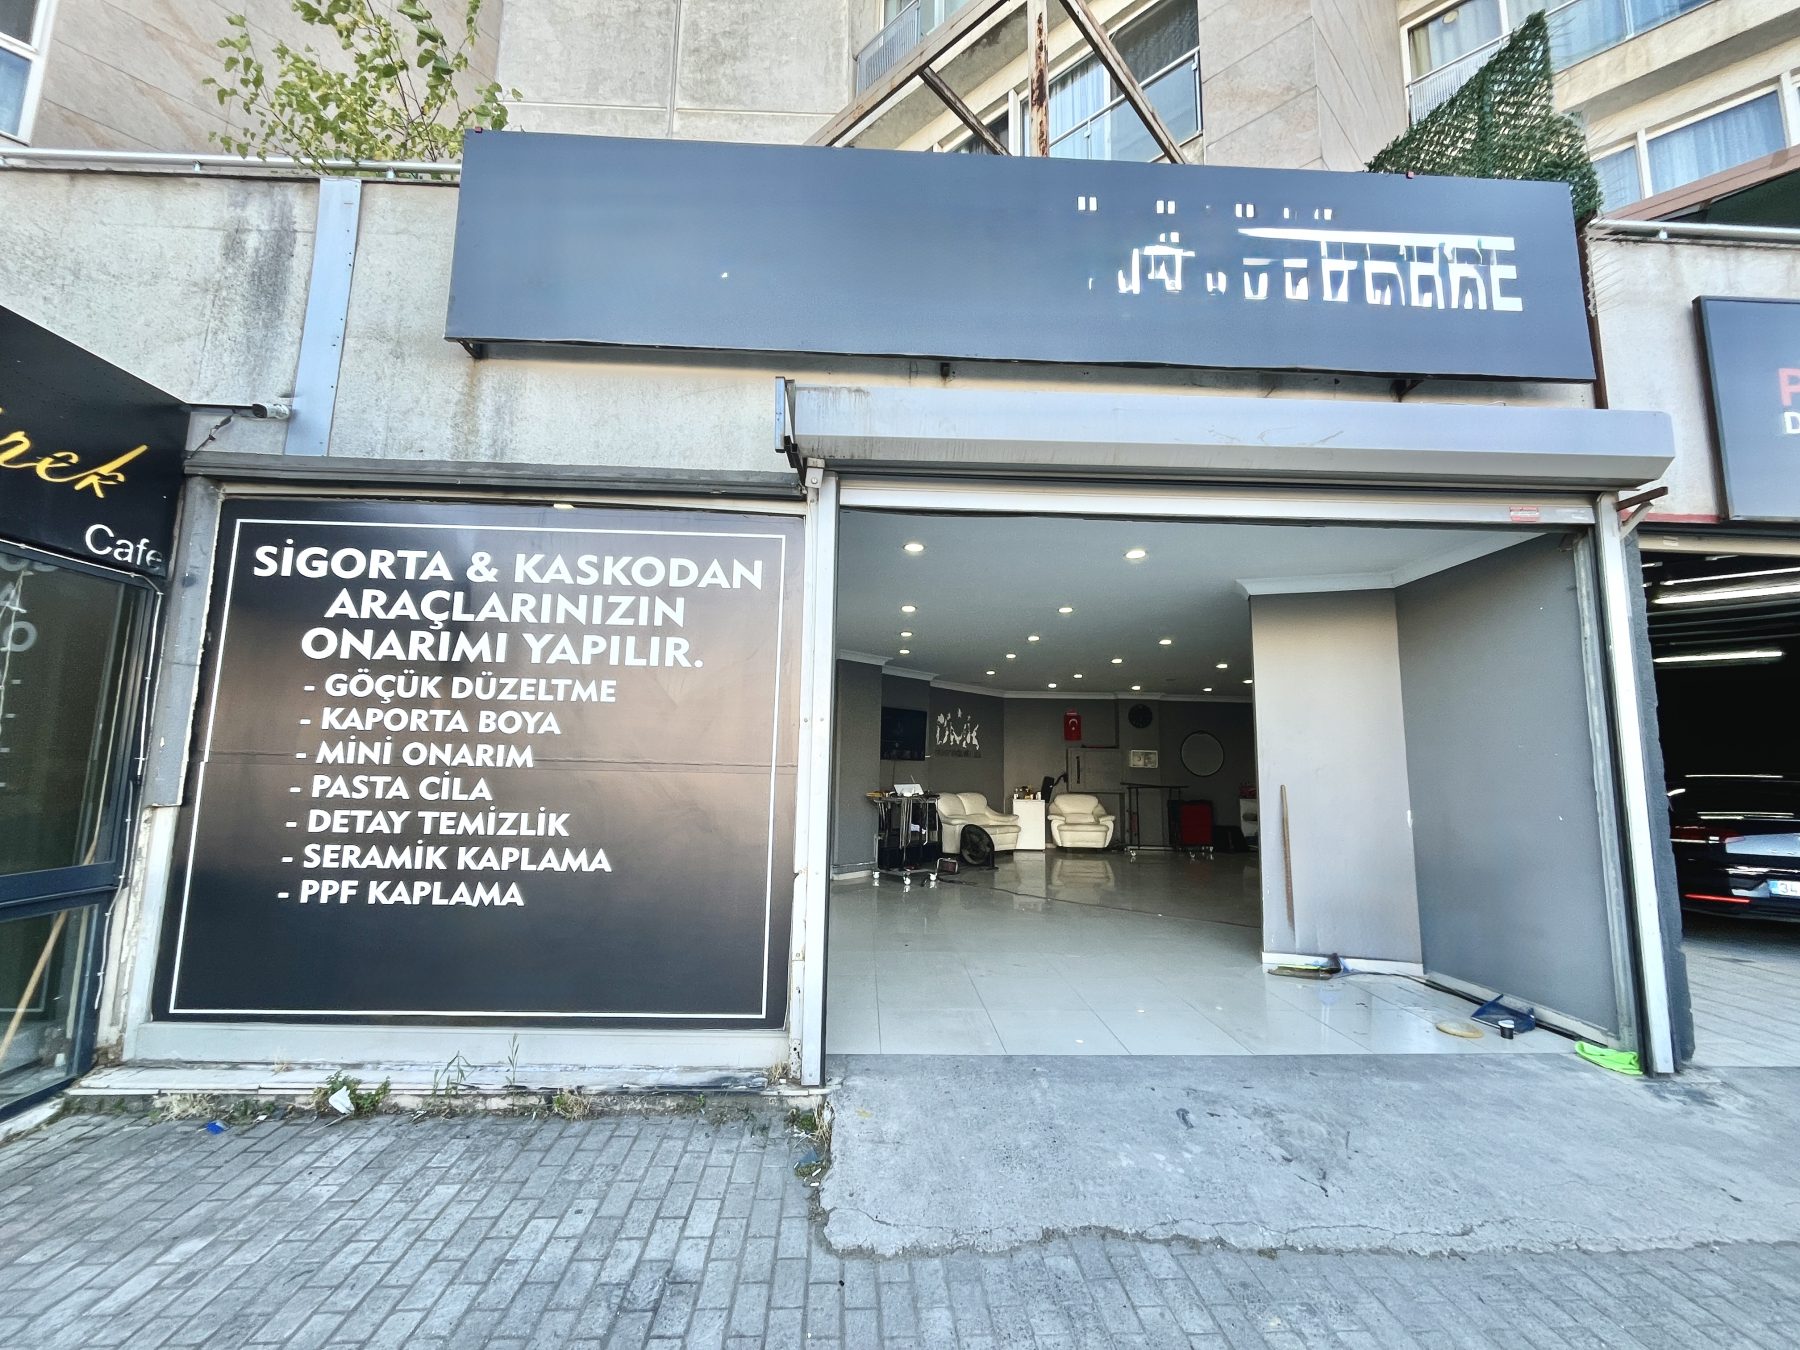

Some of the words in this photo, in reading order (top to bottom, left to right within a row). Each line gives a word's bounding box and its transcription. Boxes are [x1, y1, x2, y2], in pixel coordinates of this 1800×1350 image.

[85, 523, 163, 570] Cafe
[252, 538, 454, 581] SİGORTA
[466, 551, 498, 583] &
[514, 553, 763, 590] KASKODAN
[323, 587, 686, 631] ARAÇLARINIZIN
[301, 626, 508, 664] ONARIMI
[522, 633, 706, 668] YAPILIR.
[324, 668, 443, 704] GÖÇÜK
[451, 670, 617, 703] DÜZELTME
[321, 706, 469, 733] KAPORTA
[478, 710, 562, 735] BOYA
[315, 735, 393, 766] MİNİ
[402, 741, 534, 769] ONARIM
[311, 774, 410, 800] PASTA
[418, 770, 493, 801] CİLA
[307, 809, 412, 835] DETAY
[417, 805, 571, 837] TEMİZLİK
[303, 839, 449, 870] SERAMİK
[456, 846, 612, 873] KAPLAMA
[299, 879, 359, 904] PPF
[367, 880, 525, 908] KAPLAMA
